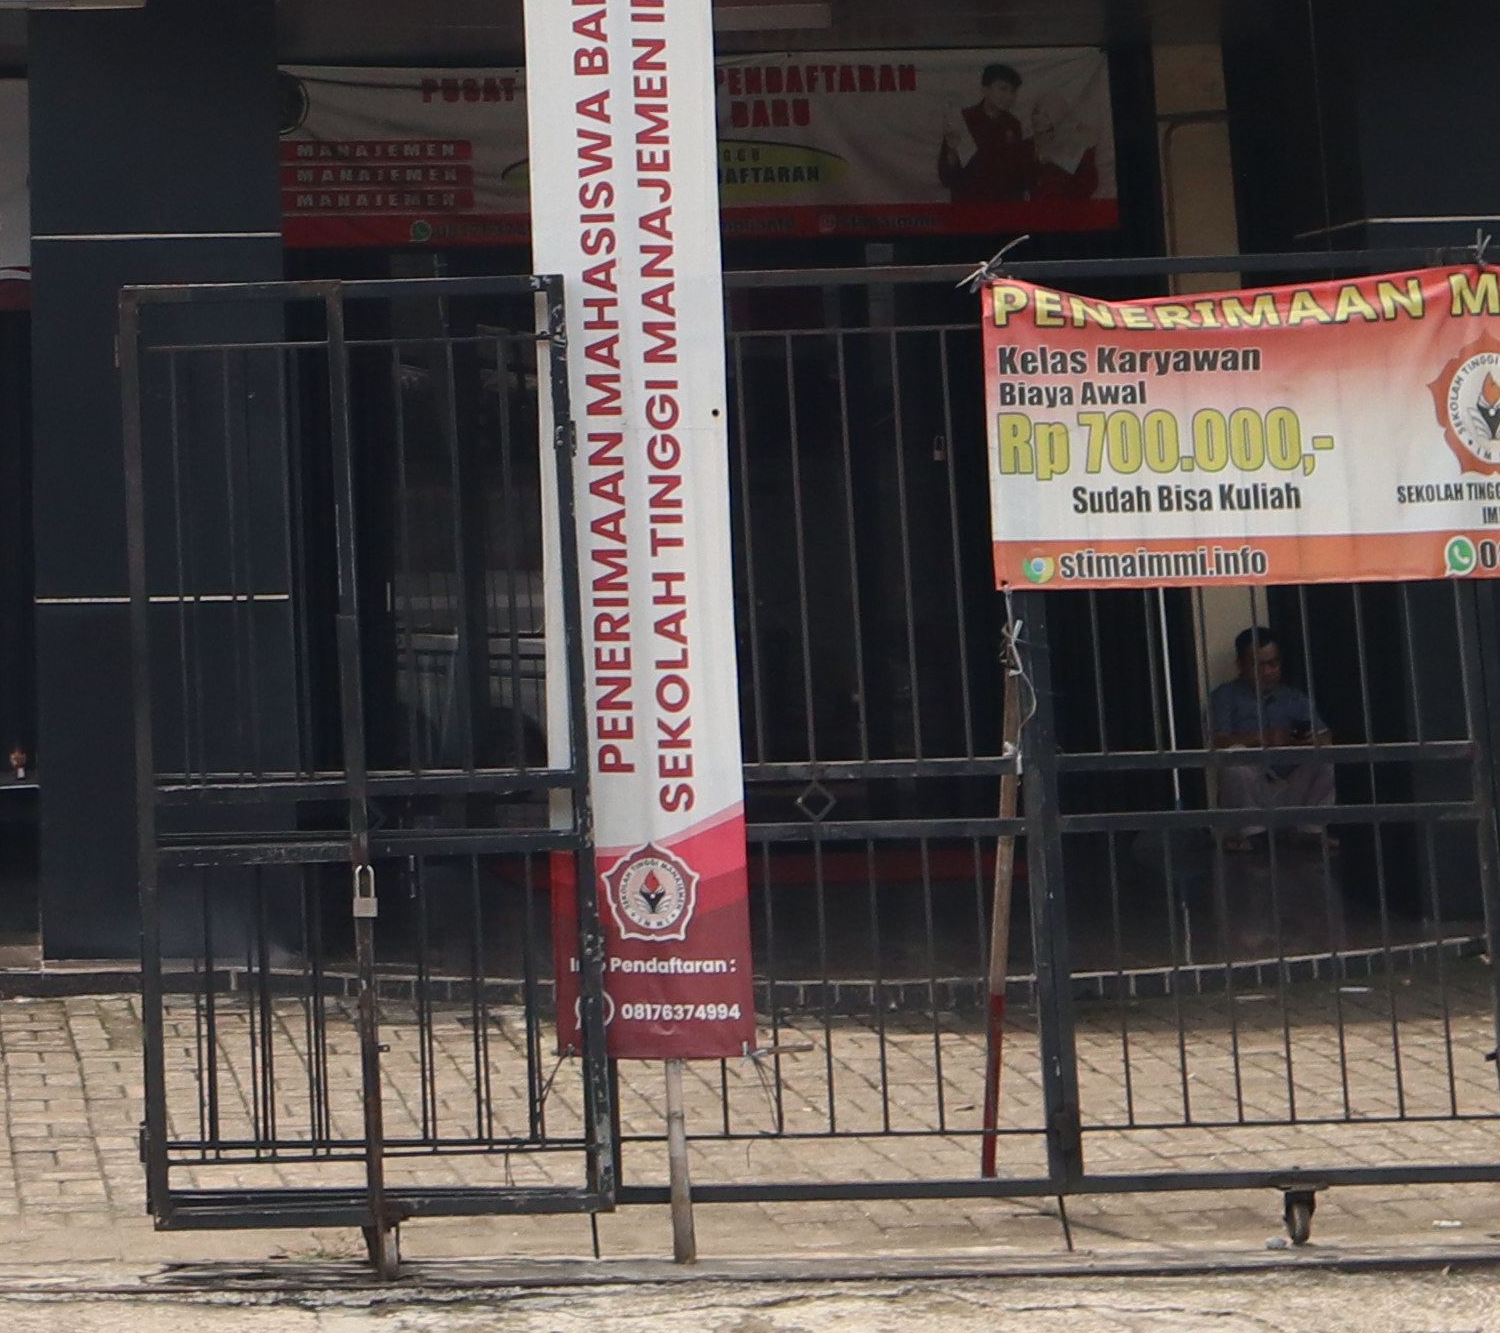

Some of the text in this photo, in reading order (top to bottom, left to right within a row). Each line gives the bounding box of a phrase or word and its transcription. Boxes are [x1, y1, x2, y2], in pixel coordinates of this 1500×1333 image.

[731, 99, 811, 129] BARU
[295, 143, 456, 159] MANAJEMEN
[295, 167, 458, 182] MANAJEMEN
[295, 192, 456, 208] MANAJEMEN
[631, 38, 679, 365] MANAJEMEN
[575, 89, 624, 417] MAHASISWA
[991, 276, 1427, 333] PENERIMAAN
[997, 345, 1263, 377] Kelas Karyawan
[997, 380, 1147, 409] Biaya Awal
[1449, 375, 1466, 436] SEKOLAH
[1460, 354, 1500, 376] TINGGI
[997, 406, 1336, 482] Rp 700.000,-
[644, 379, 689, 555] TINGGI
[1071, 481, 1302, 516] Sudah Bisa Kuliah
[1396, 484, 1464, 504] SEKOLAH
[1058, 543, 1270, 580] stimaimmi.info
[588, 431, 638, 776] PENERIMAAN
[650, 569, 698, 814] SEKOLAH
[610, 956, 727, 975] Pendaftaran
[621, 1002, 742, 1021] 08176374994
